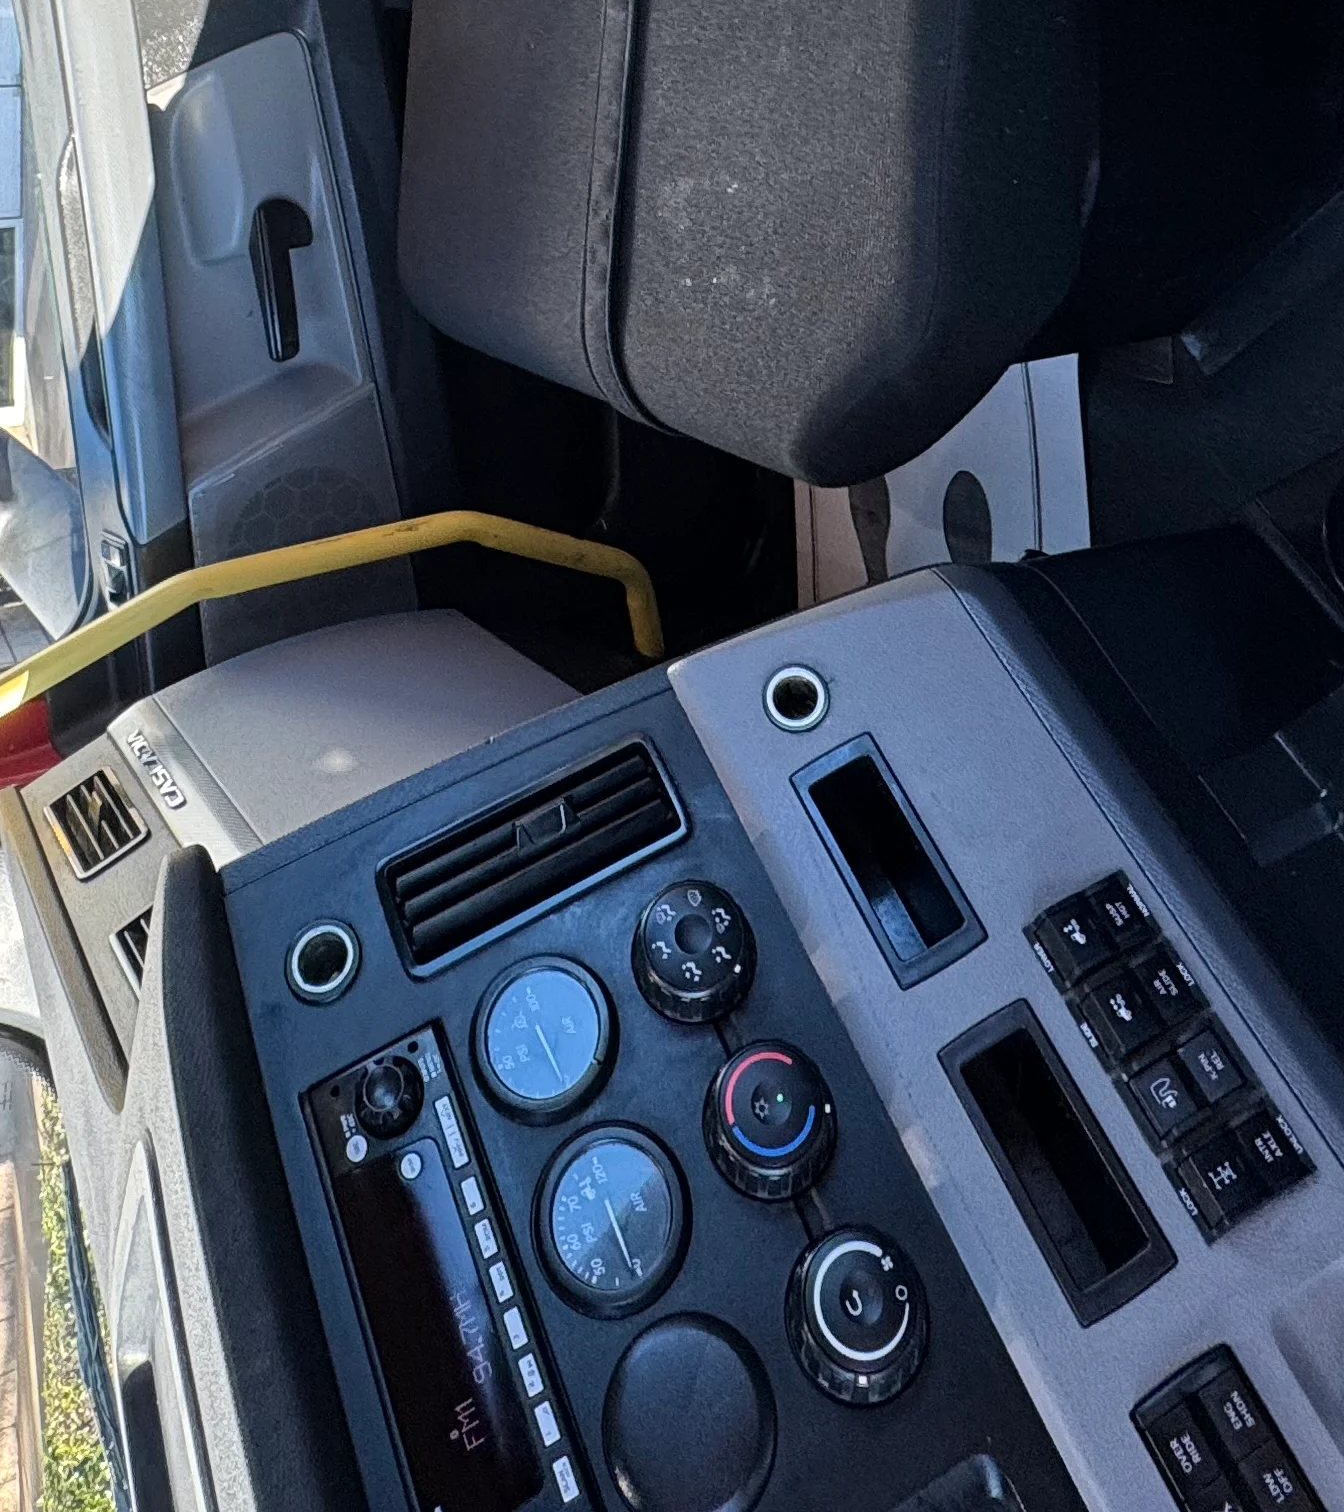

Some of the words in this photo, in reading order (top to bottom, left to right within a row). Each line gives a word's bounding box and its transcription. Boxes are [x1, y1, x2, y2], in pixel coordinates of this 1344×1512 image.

[1127, 884, 1150, 918] NORMAL
[1033, 942, 1055, 973] LOWER
[1153, 979, 1168, 995] AIR
[1157, 968, 1179, 996] SLIDE
[1176, 962, 1195, 987] LOCK
[561, 1015, 577, 1035] AIR
[1080, 1023, 1099, 1048] SLIDE
[503, 1054, 516, 1071] 50
[516, 1043, 531, 1062] PSI
[1212, 1049, 1225, 1070] REL
[1264, 1130, 1283, 1158] AXLE
[1276, 1114, 1304, 1155] UNLOCK
[1255, 1137, 1274, 1163] INTR
[593, 1164, 608, 1185] 120
[567, 1195, 582, 1213] 70
[629, 1191, 648, 1213] AIR
[1179, 1188, 1198, 1216] LOCK
[566, 1233, 581, 1251] 60
[581, 1223, 598, 1243] PSI
[591, 1258, 606, 1276] 50
[1223, 1401, 1244, 1431] ENG
[1230, 1390, 1256, 1428] SHDN
[454, 1398, 486, 1451] FM1
[1169, 1437, 1193, 1474] OVER
[1180, 1431, 1202, 1465] RIDE
[1262, 1473, 1286, 1504] LDW
[1273, 1467, 1294, 1494] OFF
